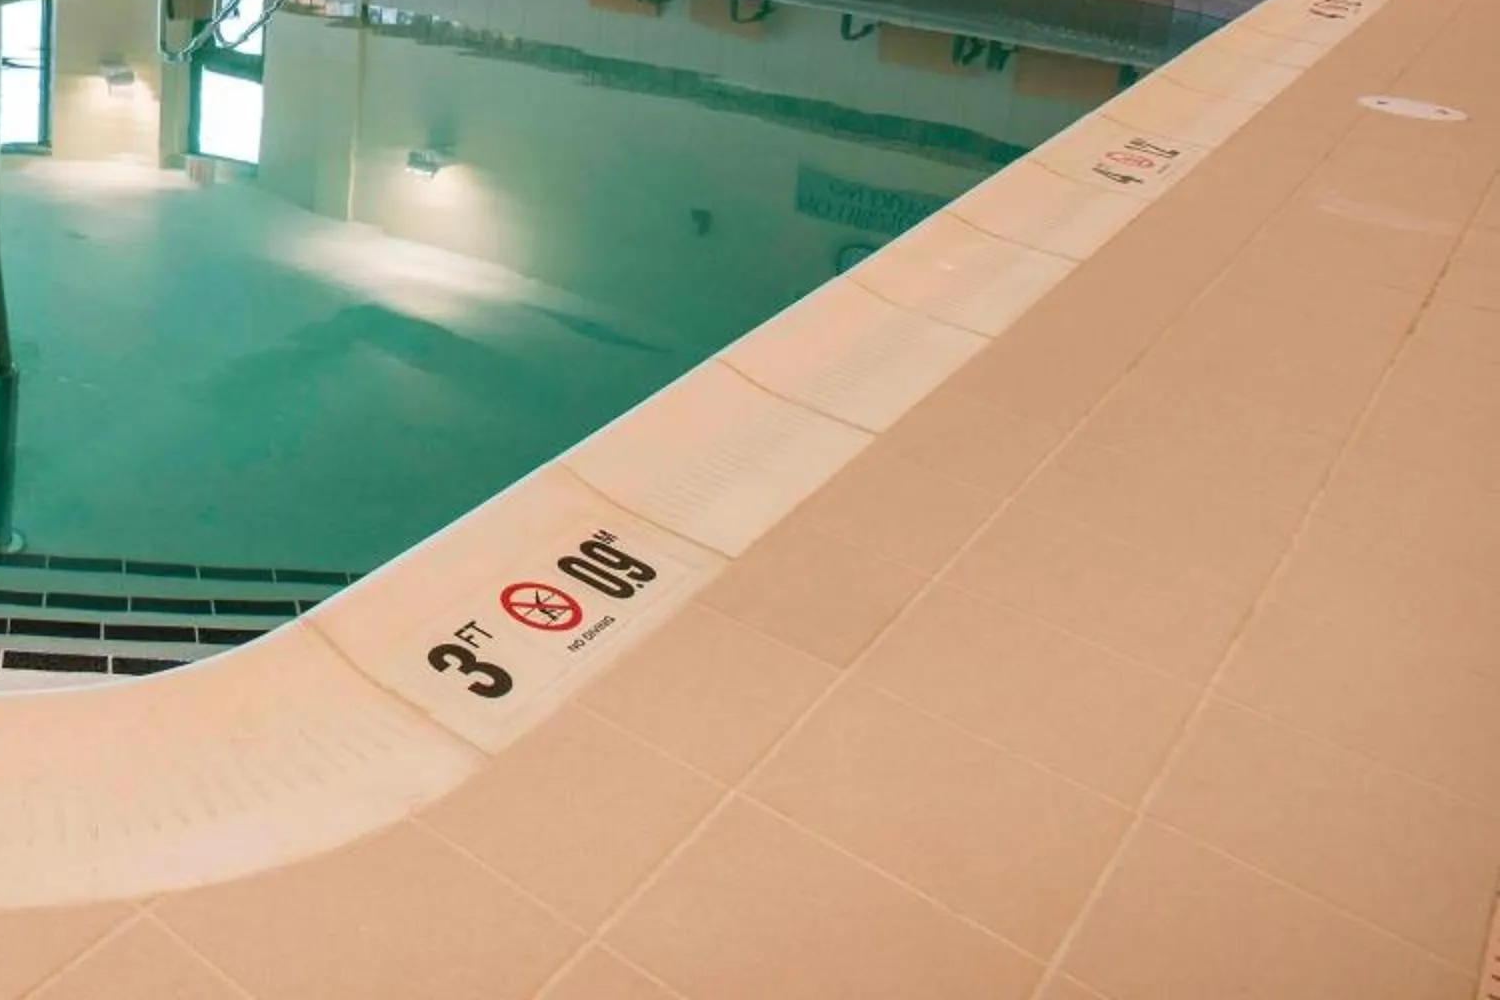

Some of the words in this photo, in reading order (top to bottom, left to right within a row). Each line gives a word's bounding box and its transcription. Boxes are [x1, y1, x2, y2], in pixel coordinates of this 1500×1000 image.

[454, 621, 493, 648] FT
[567, 638, 586, 652] NO
[582, 615, 616, 641] DIVING
[427, 643, 513, 698] 3
